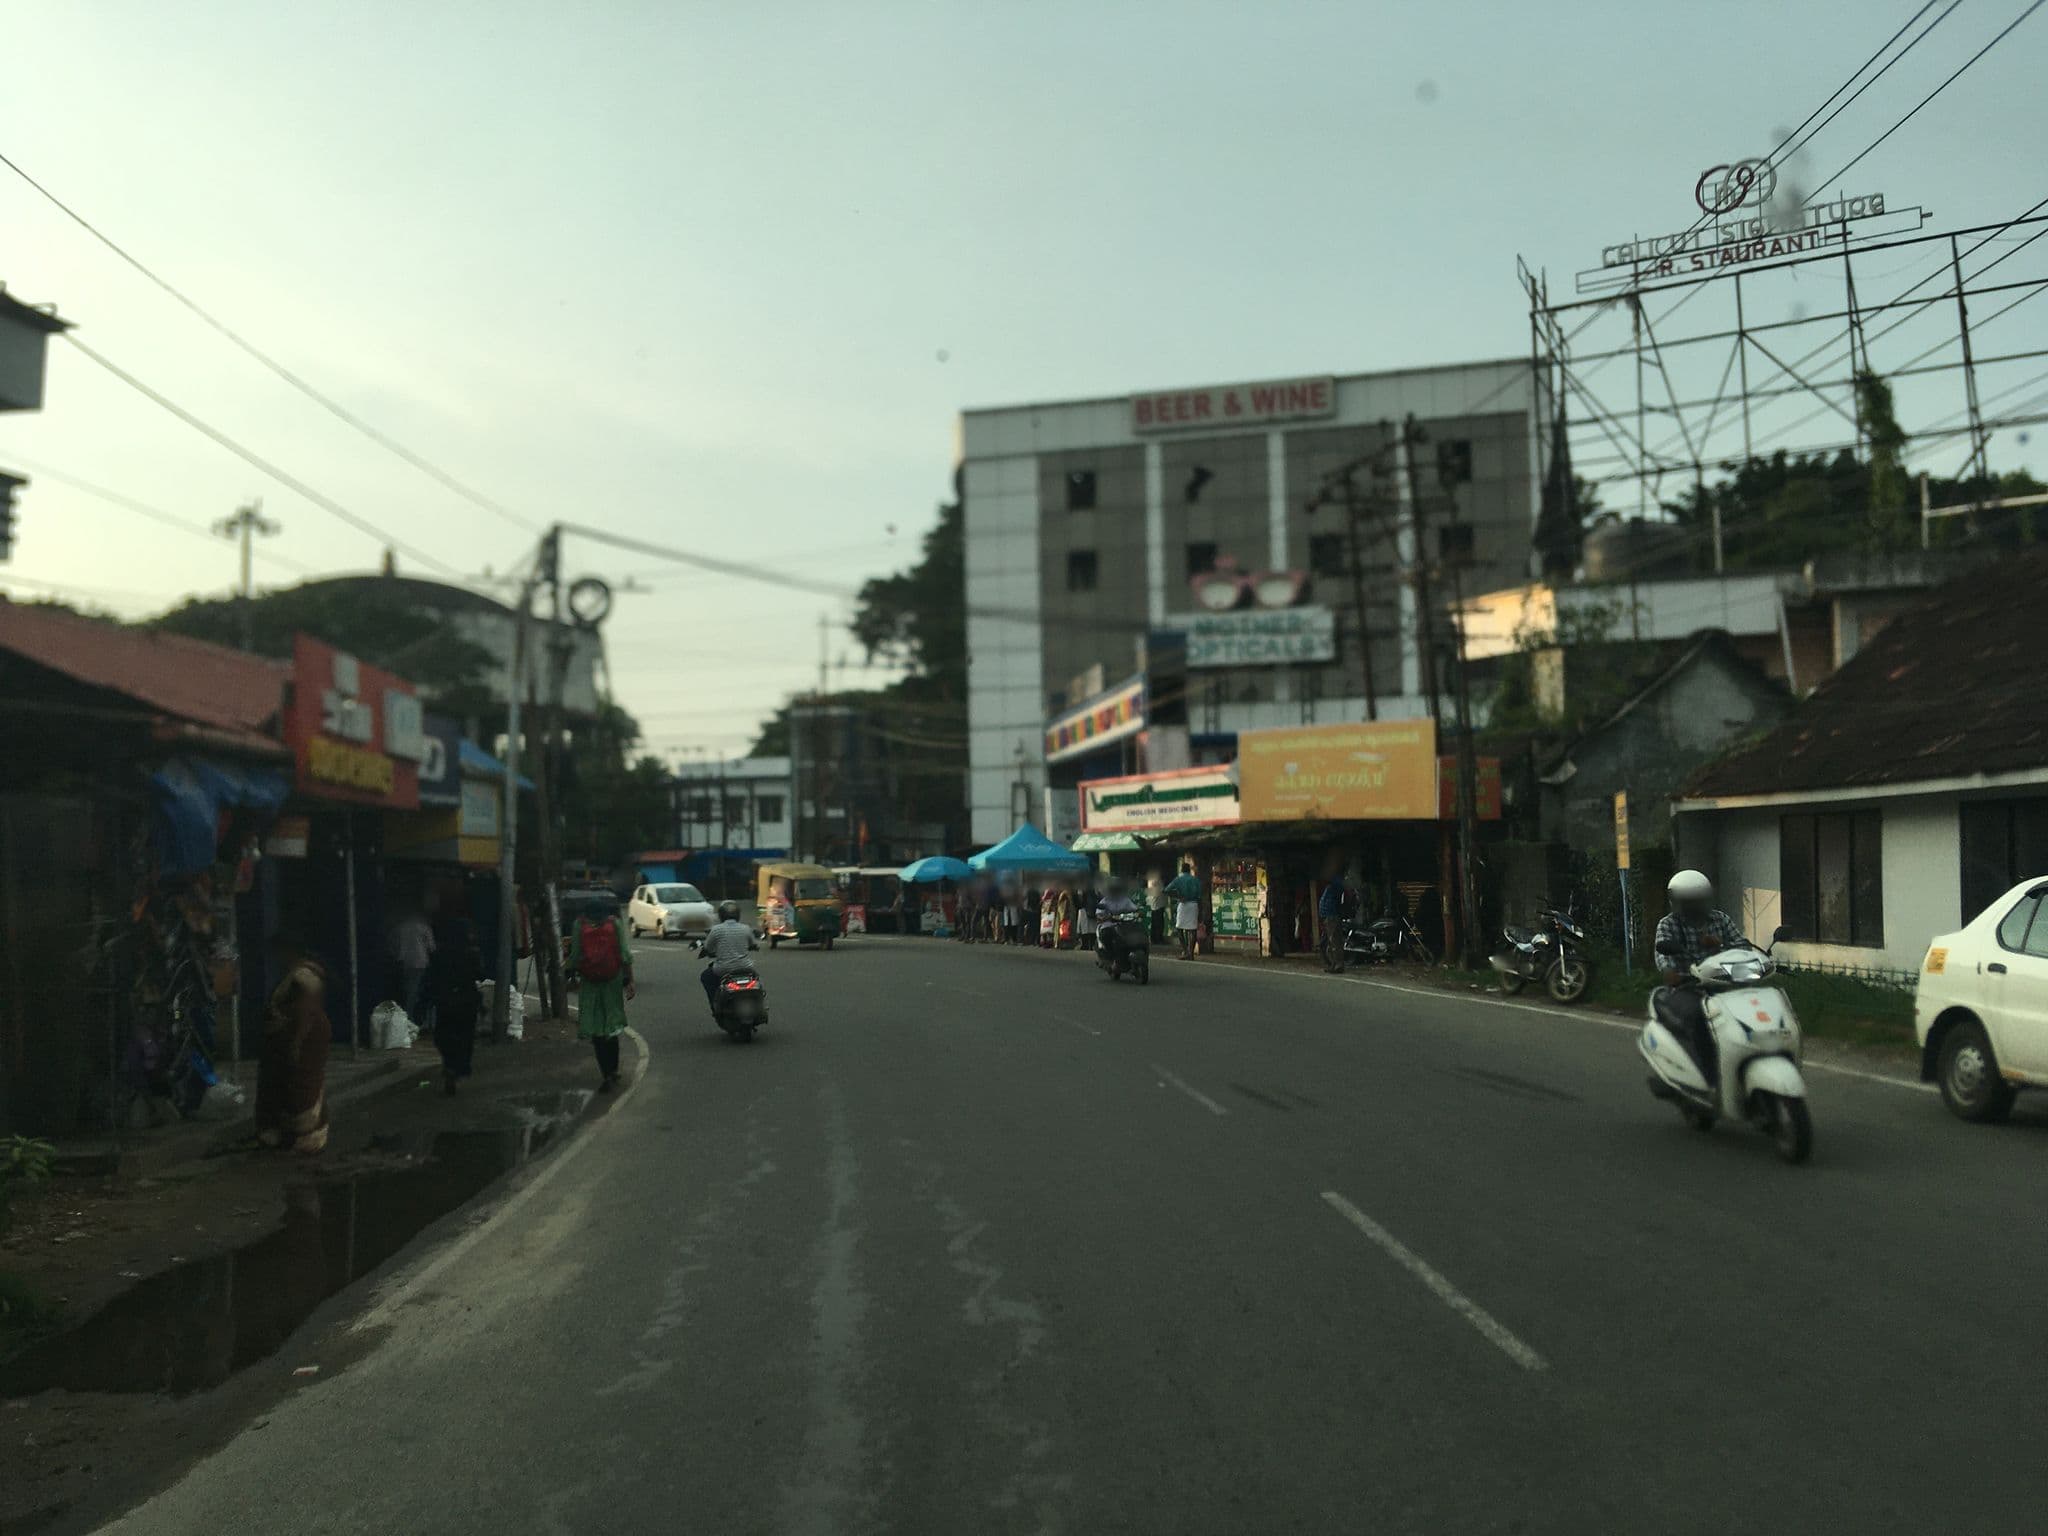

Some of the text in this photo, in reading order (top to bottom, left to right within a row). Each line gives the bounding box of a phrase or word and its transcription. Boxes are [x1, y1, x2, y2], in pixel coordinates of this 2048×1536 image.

[1135, 381, 1329, 425] BEER & WINE
